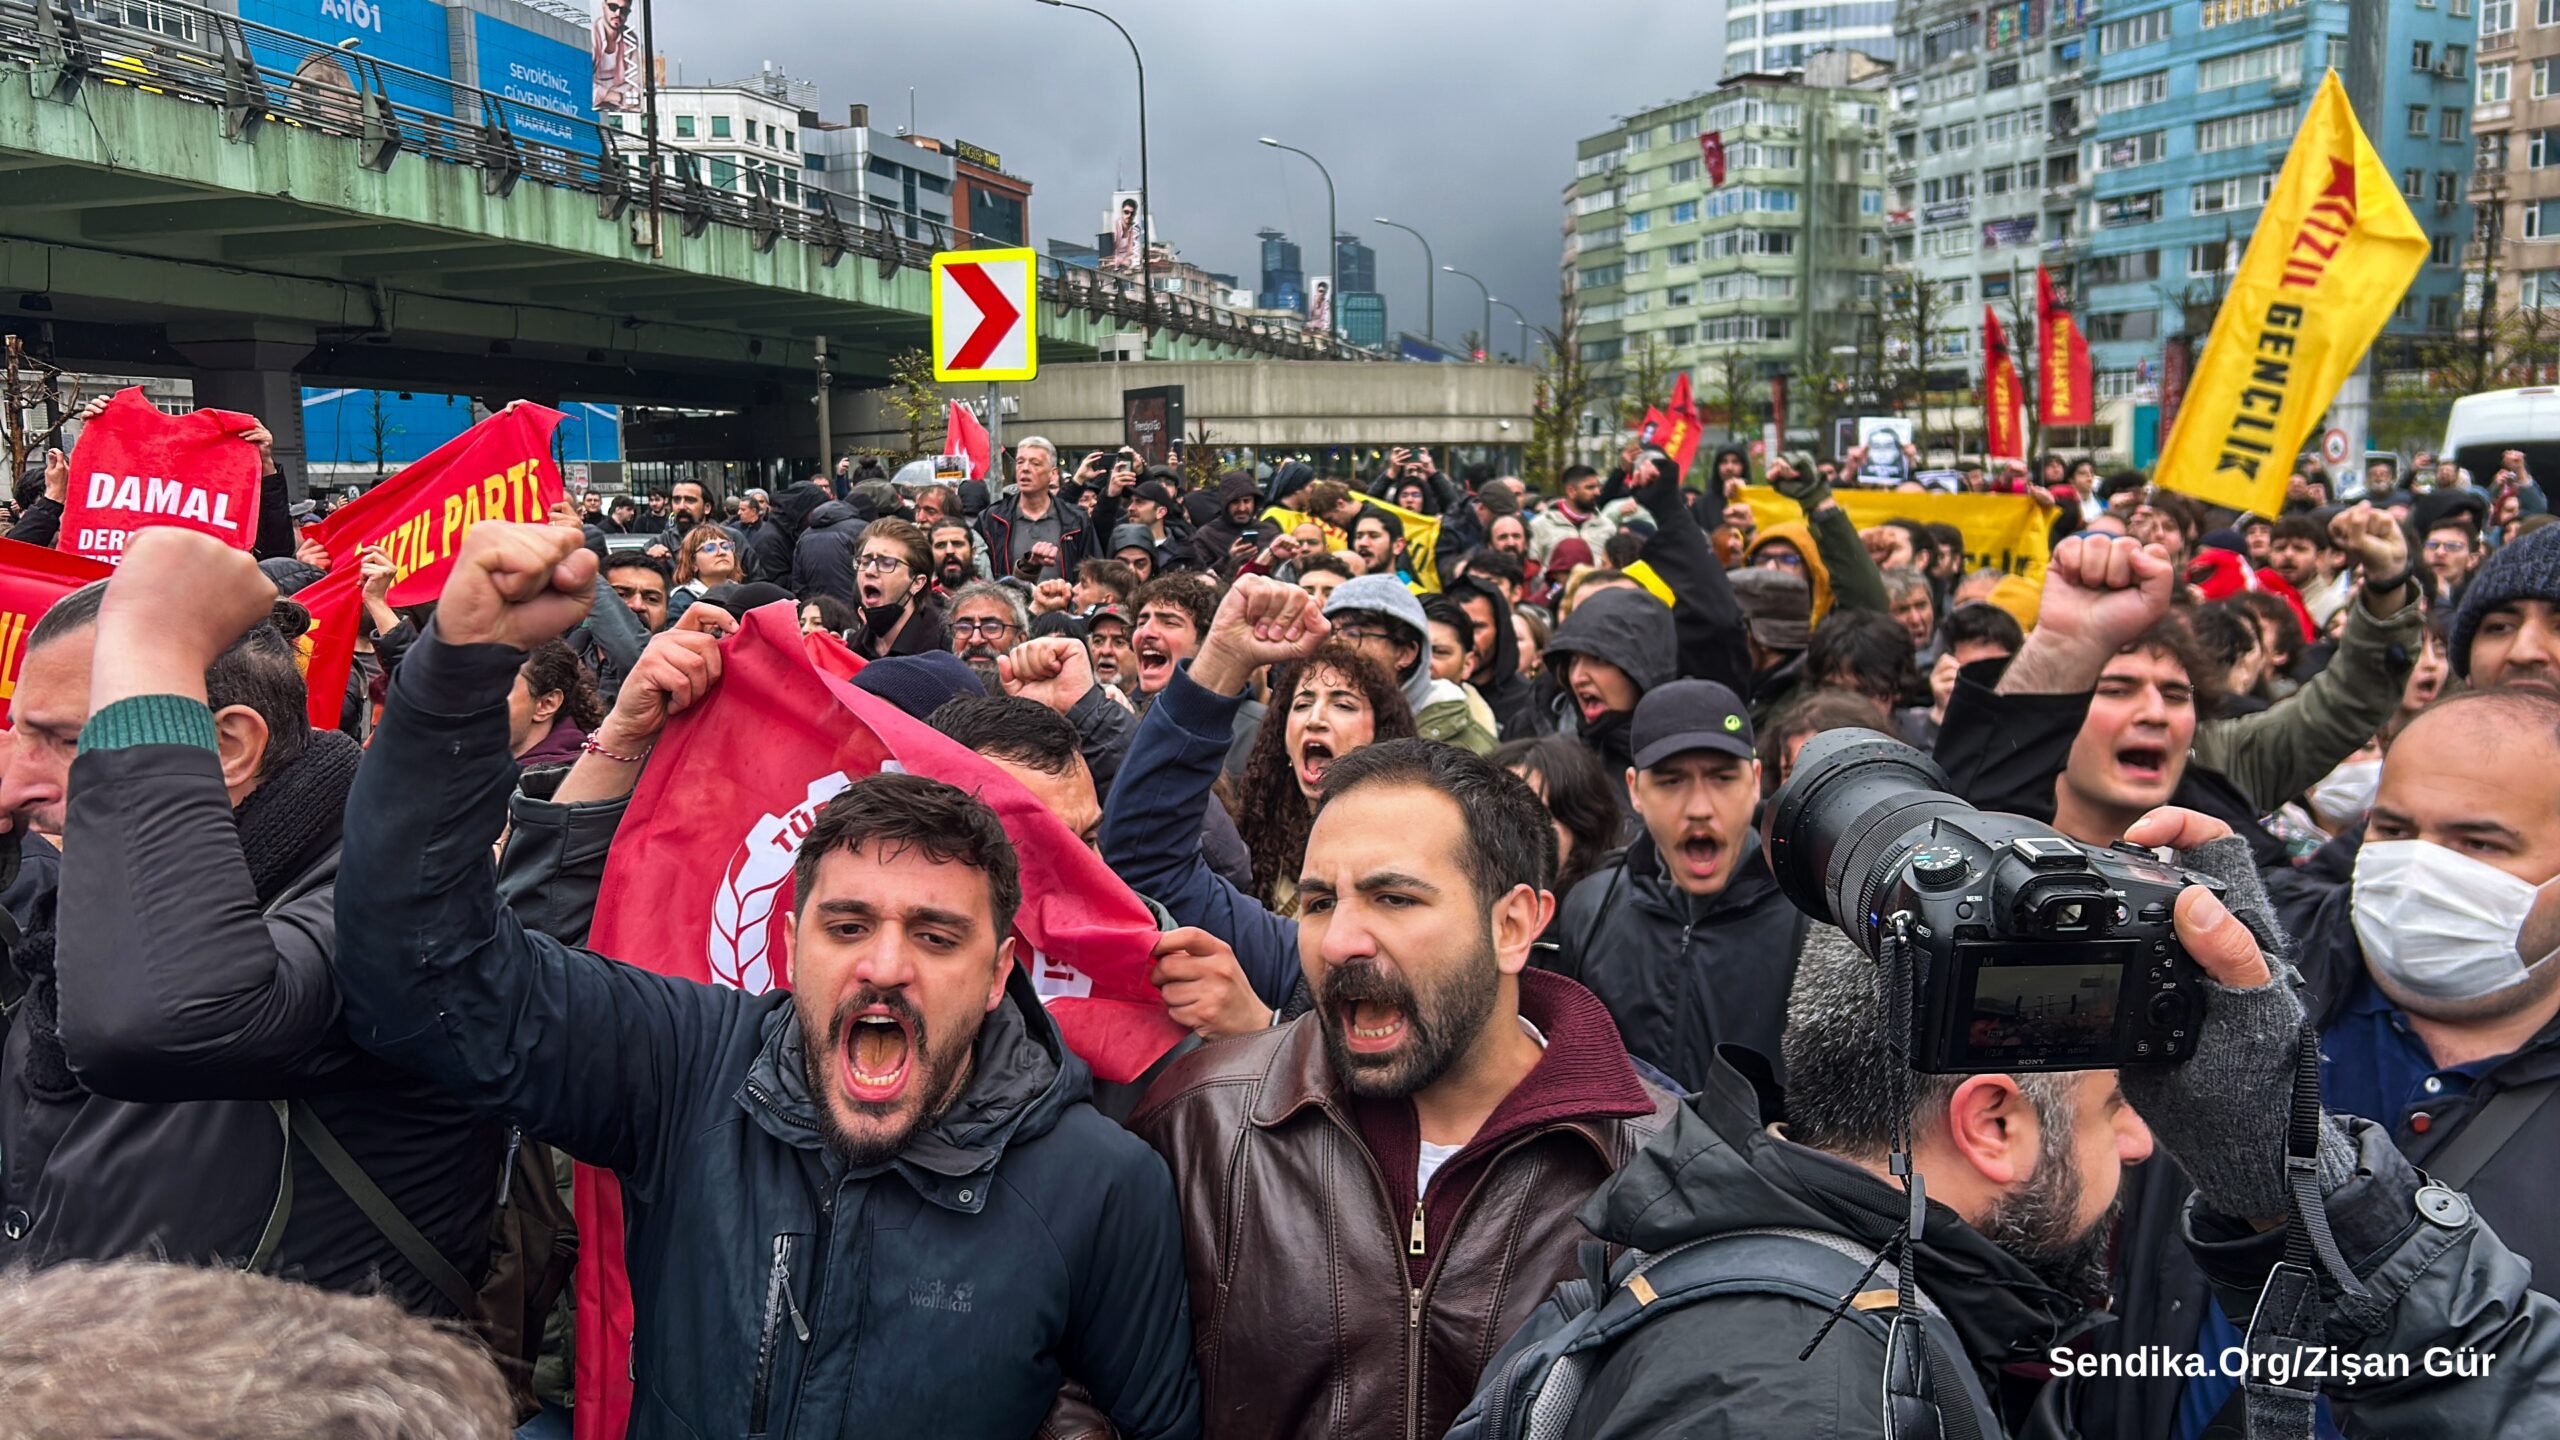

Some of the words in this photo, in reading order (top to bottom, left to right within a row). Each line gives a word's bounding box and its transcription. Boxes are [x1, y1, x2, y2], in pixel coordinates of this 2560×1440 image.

[514, 113, 573, 140] MARKALAR
[2215, 302, 2303, 482] GENÇLİK
[86, 472, 238, 530] DAMAL
[78, 528, 133, 551] DER
[373, 508, 436, 589] IZIL
[2017, 1058, 2046, 1066] SONY
[908, 1290, 973, 1313] Wolfskin
